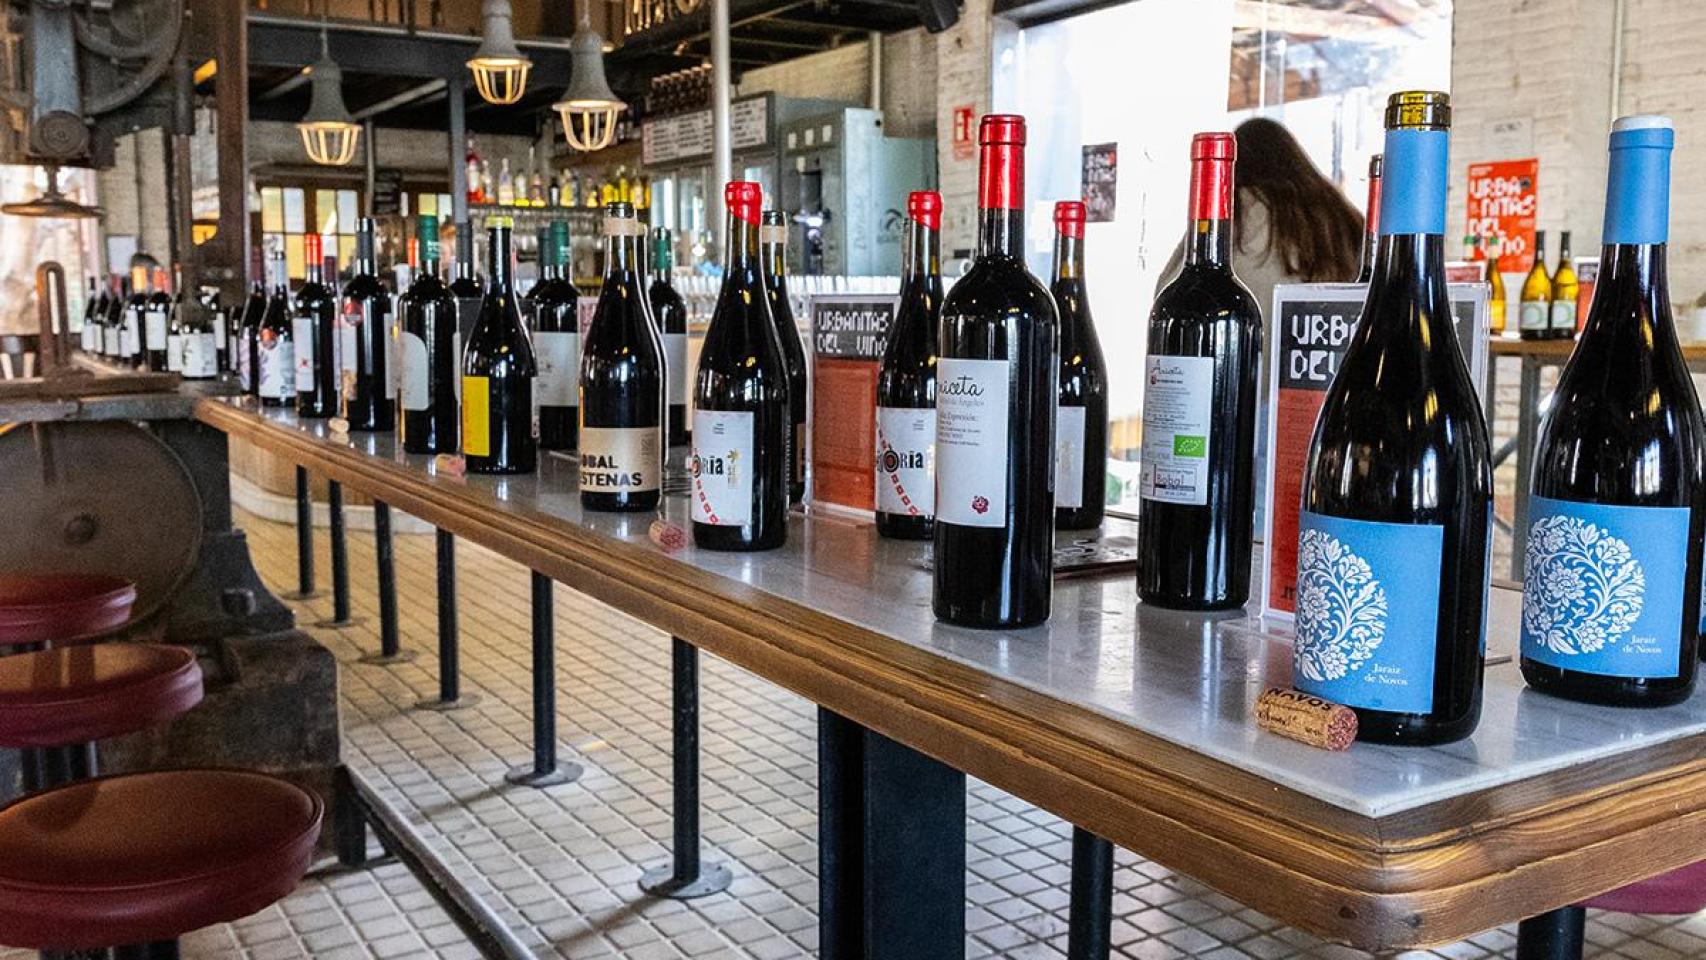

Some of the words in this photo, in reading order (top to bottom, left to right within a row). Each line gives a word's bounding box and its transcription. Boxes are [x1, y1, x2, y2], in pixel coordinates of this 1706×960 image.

[818, 311, 888, 331] URBANITAS
[817, 333, 842, 353] DEL
[1363, 673, 1377, 683] de
